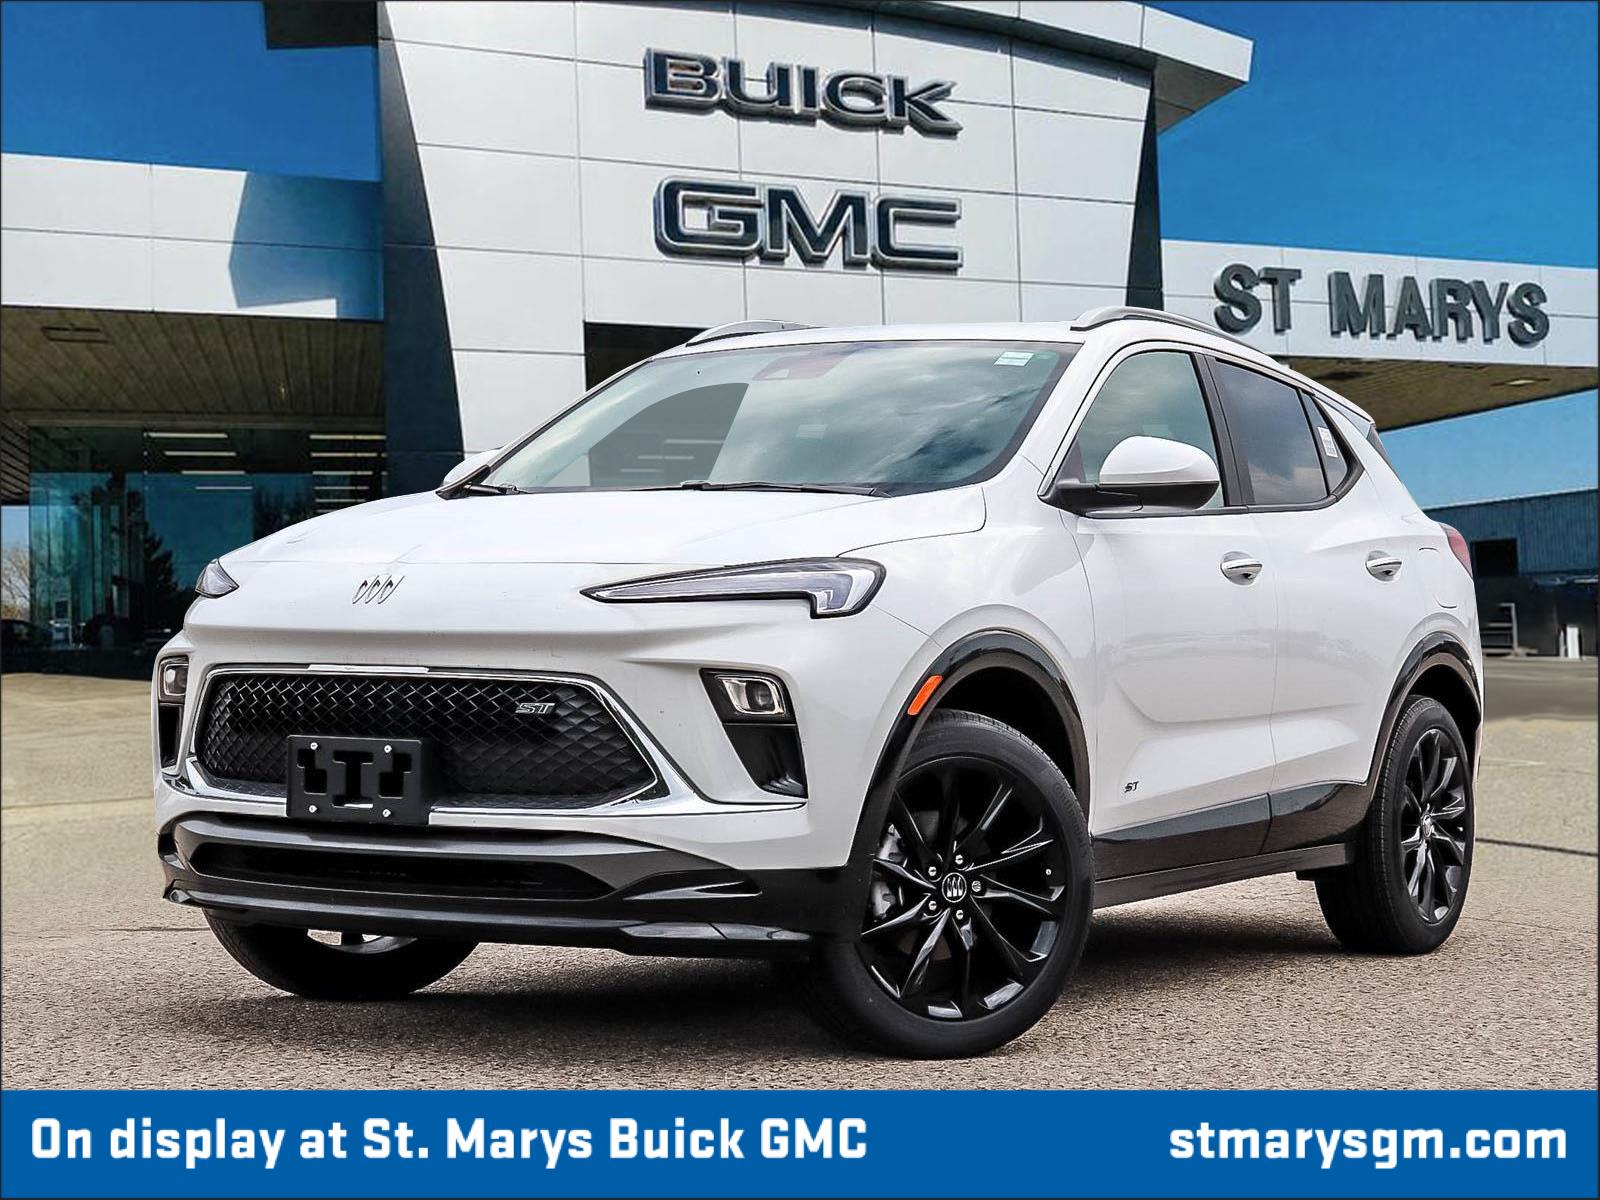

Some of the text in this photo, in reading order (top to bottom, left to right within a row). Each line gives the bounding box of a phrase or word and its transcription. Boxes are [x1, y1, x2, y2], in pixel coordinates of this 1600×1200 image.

[644, 48, 963, 136] BUICK
[654, 176, 964, 271] GMC
[1213, 263, 1550, 347] ST MARYS
[515, 702, 556, 714] ST
